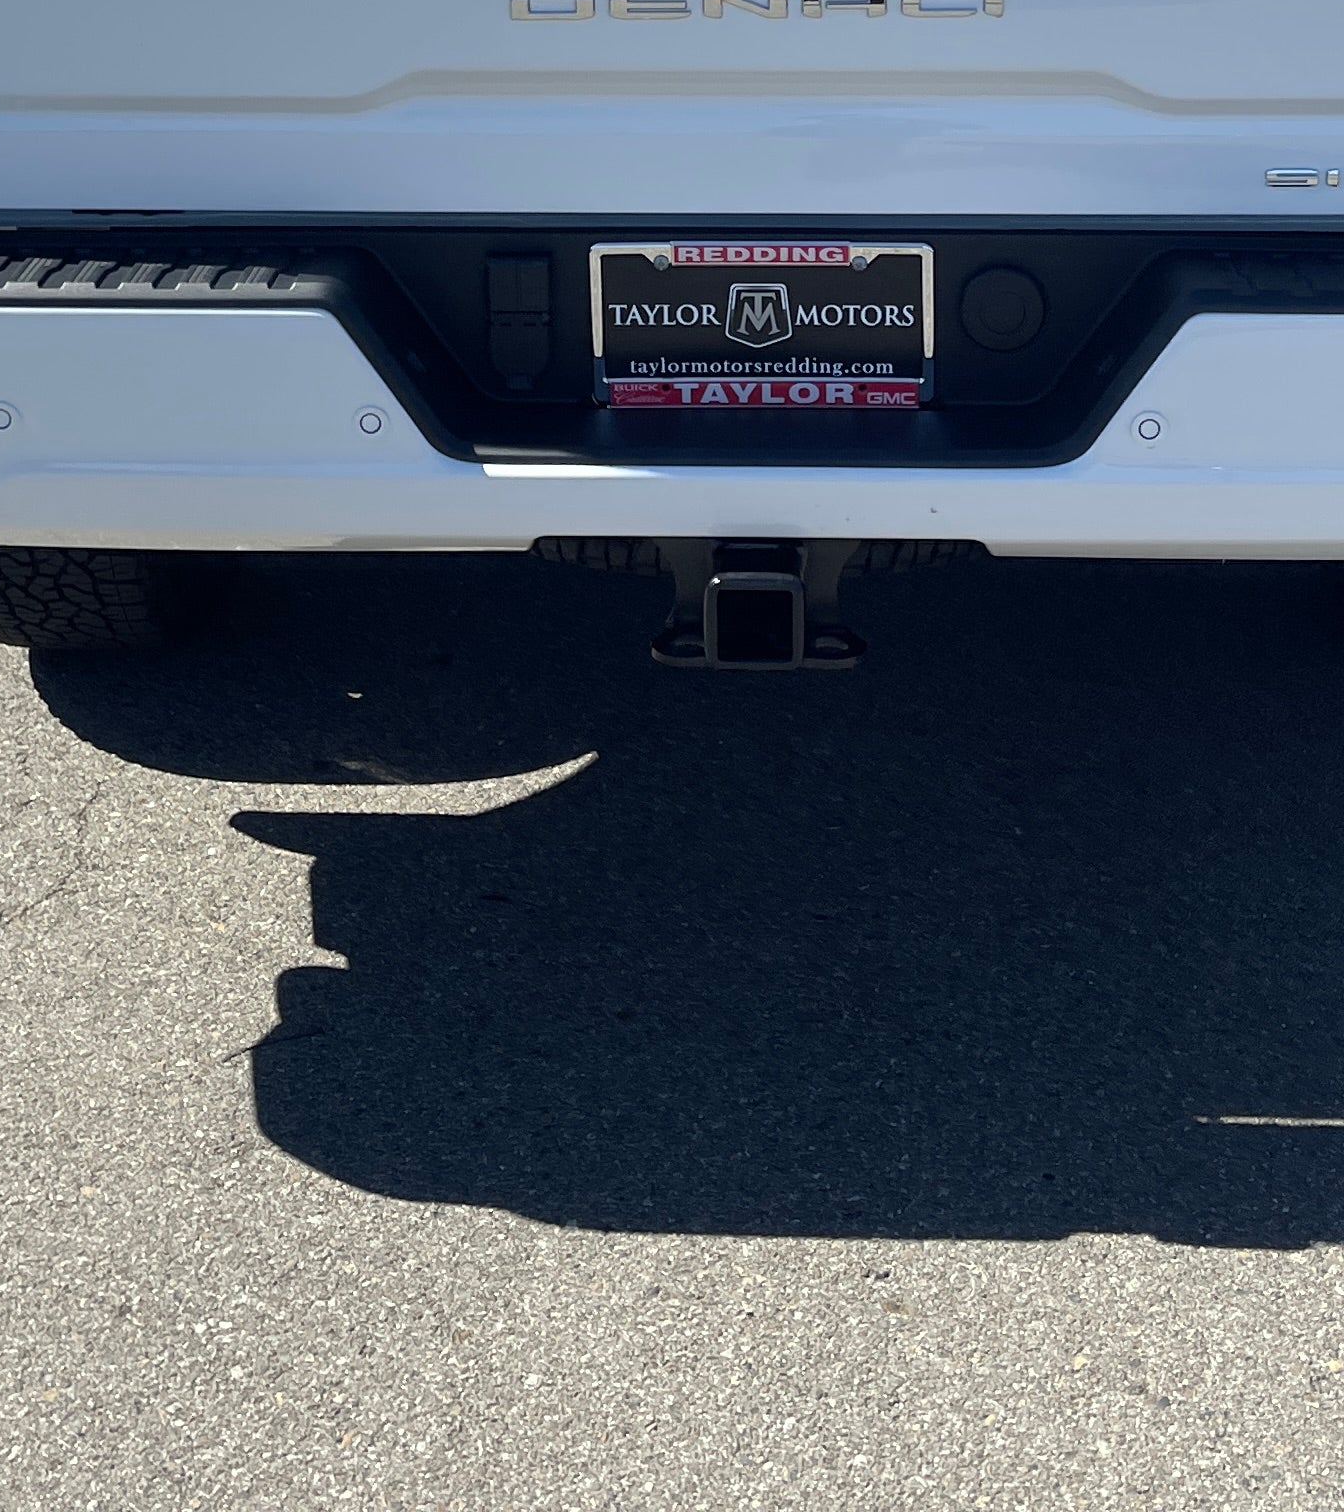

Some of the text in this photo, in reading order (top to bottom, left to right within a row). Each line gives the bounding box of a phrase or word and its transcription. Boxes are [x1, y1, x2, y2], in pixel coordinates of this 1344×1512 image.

[677, 246, 844, 262] REDDING
[608, 304, 722, 326] TAYLOR
[795, 304, 915, 327] MOTORS
[630, 357, 894, 376] taylormotorsredding.com
[673, 382, 855, 404] TAYLOR
[866, 392, 916, 405] GMC
